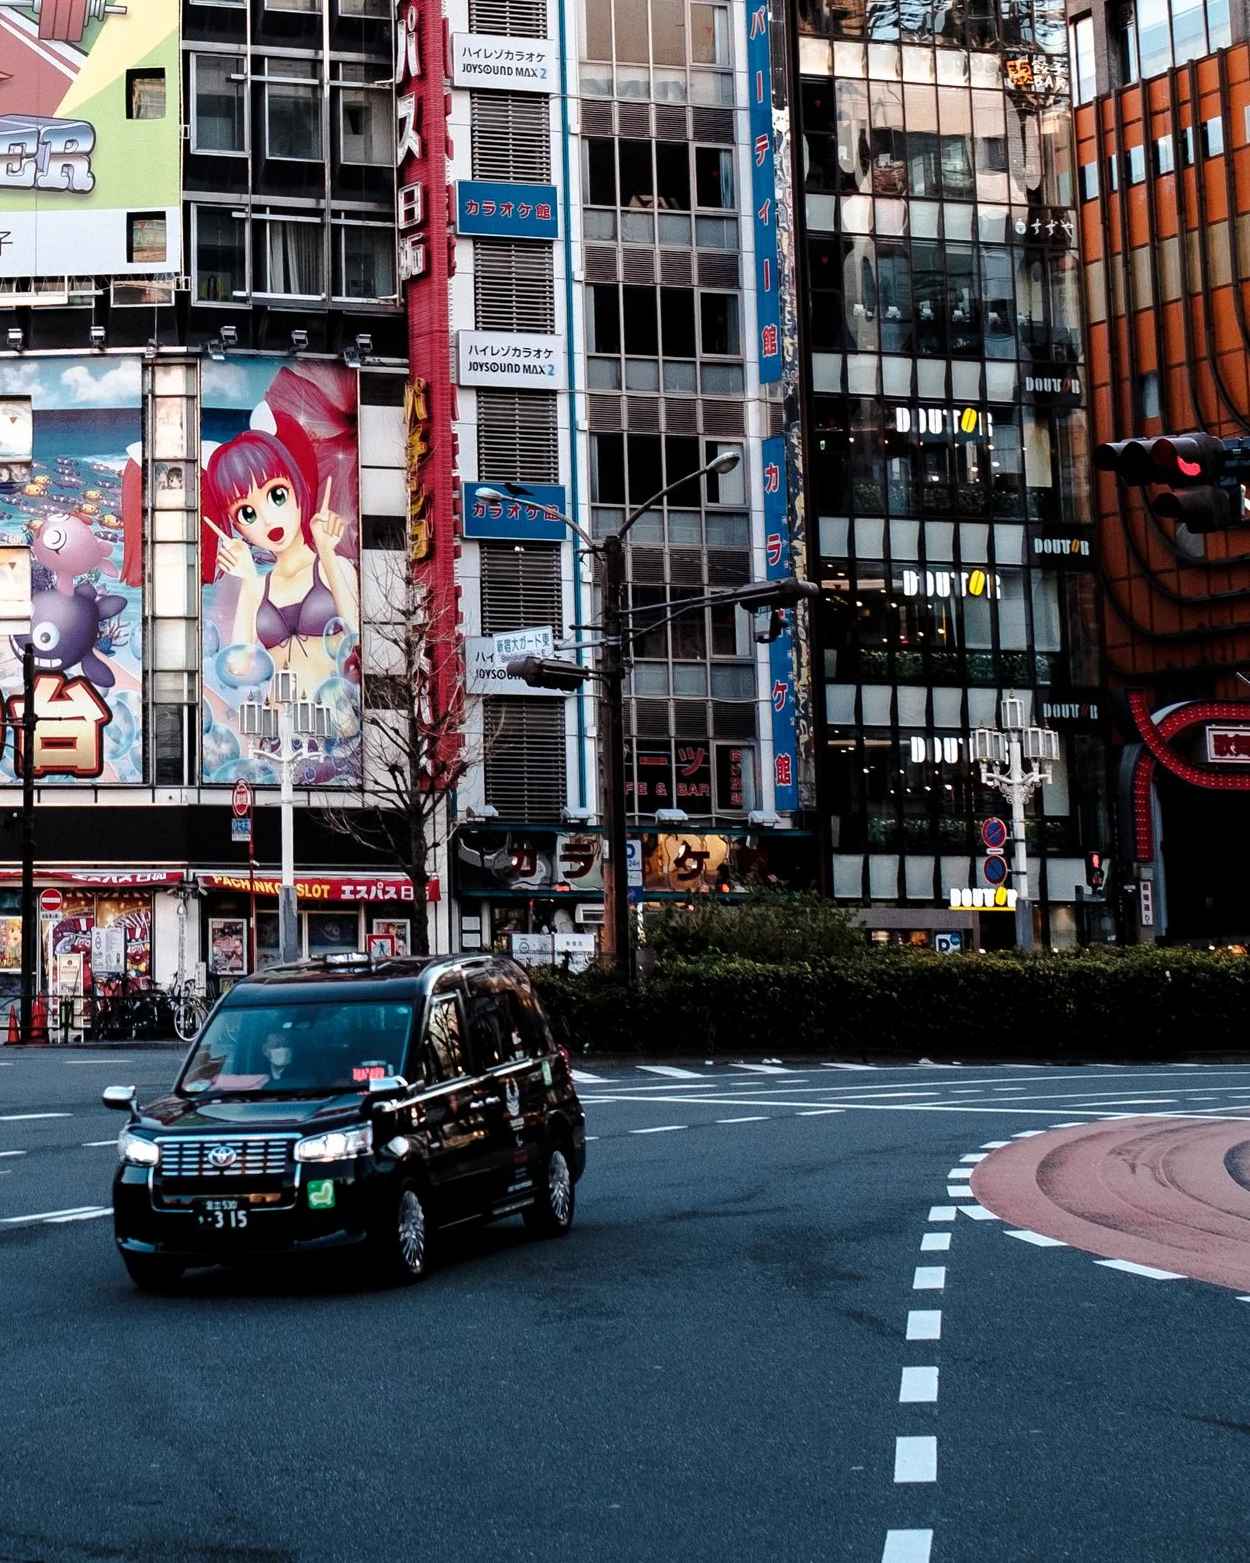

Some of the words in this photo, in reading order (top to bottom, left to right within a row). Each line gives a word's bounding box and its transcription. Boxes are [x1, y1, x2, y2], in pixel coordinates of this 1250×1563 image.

[462, 47, 547, 62] ハイレゾカラオケ
[462, 63, 513, 77] JOYSOUND
[1033, 75, 1068, 89] BAR
[465, 199, 551, 220] カラオケ館
[468, 344, 554, 360] ハイレゾカラオケ
[468, 360, 521, 374] JOYSOUND
[1025, 376, 1081, 394] DOUTOR
[1034, 538, 1090, 556] DOUTOR
[763, 462, 792, 786] カラケ館
[1043, 702, 1099, 720] DOUTOR
[676, 782, 711, 797] BAR
[296, 883, 330, 898] SLOT
[340, 881, 398, 900] エスパス
